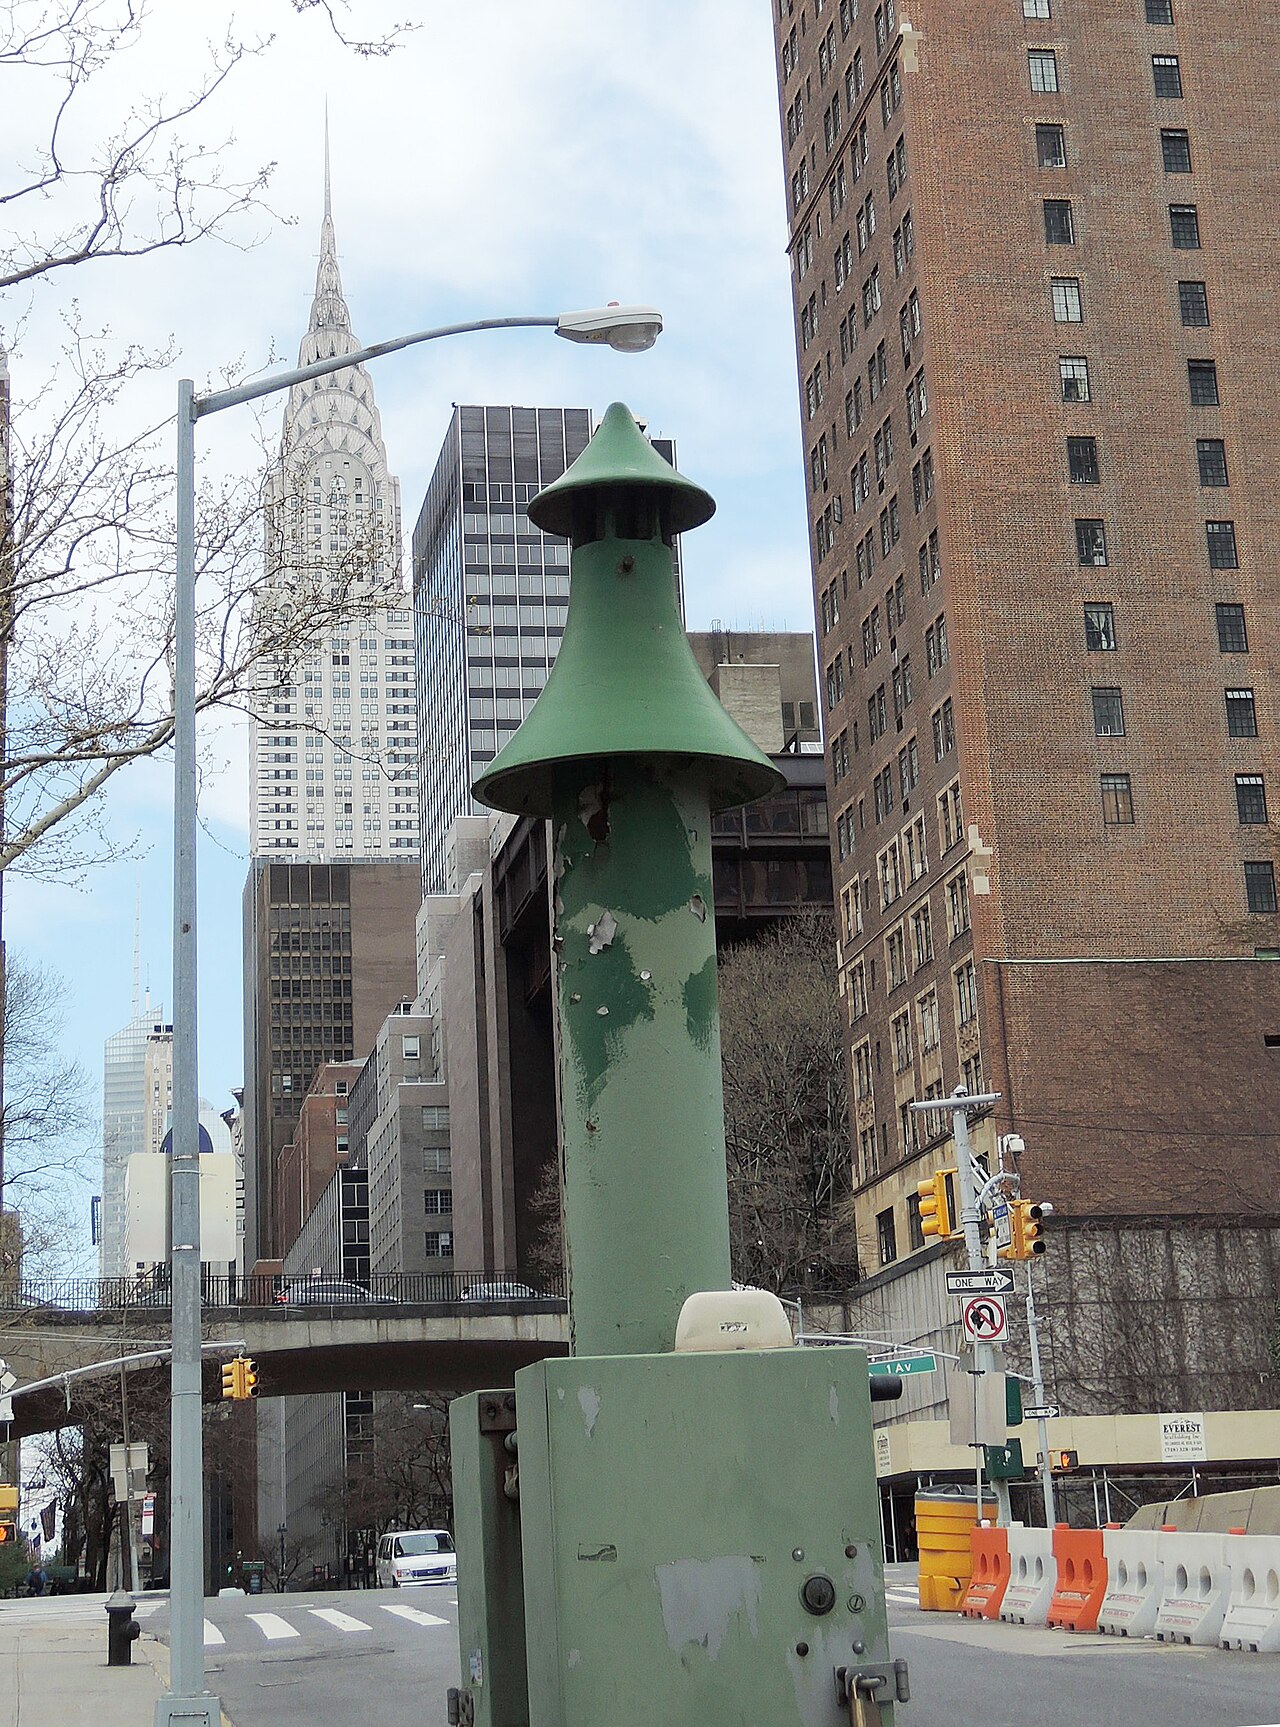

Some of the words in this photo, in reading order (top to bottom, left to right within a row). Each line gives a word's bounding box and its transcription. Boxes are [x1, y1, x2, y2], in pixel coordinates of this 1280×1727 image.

[955, 1278, 974, 1288] ONE
[984, 1276, 1004, 1286] WAY
[886, 1363, 892, 1374] 1
[895, 1362, 912, 1373] Av
[1163, 1423, 1201, 1433] EVEREST
